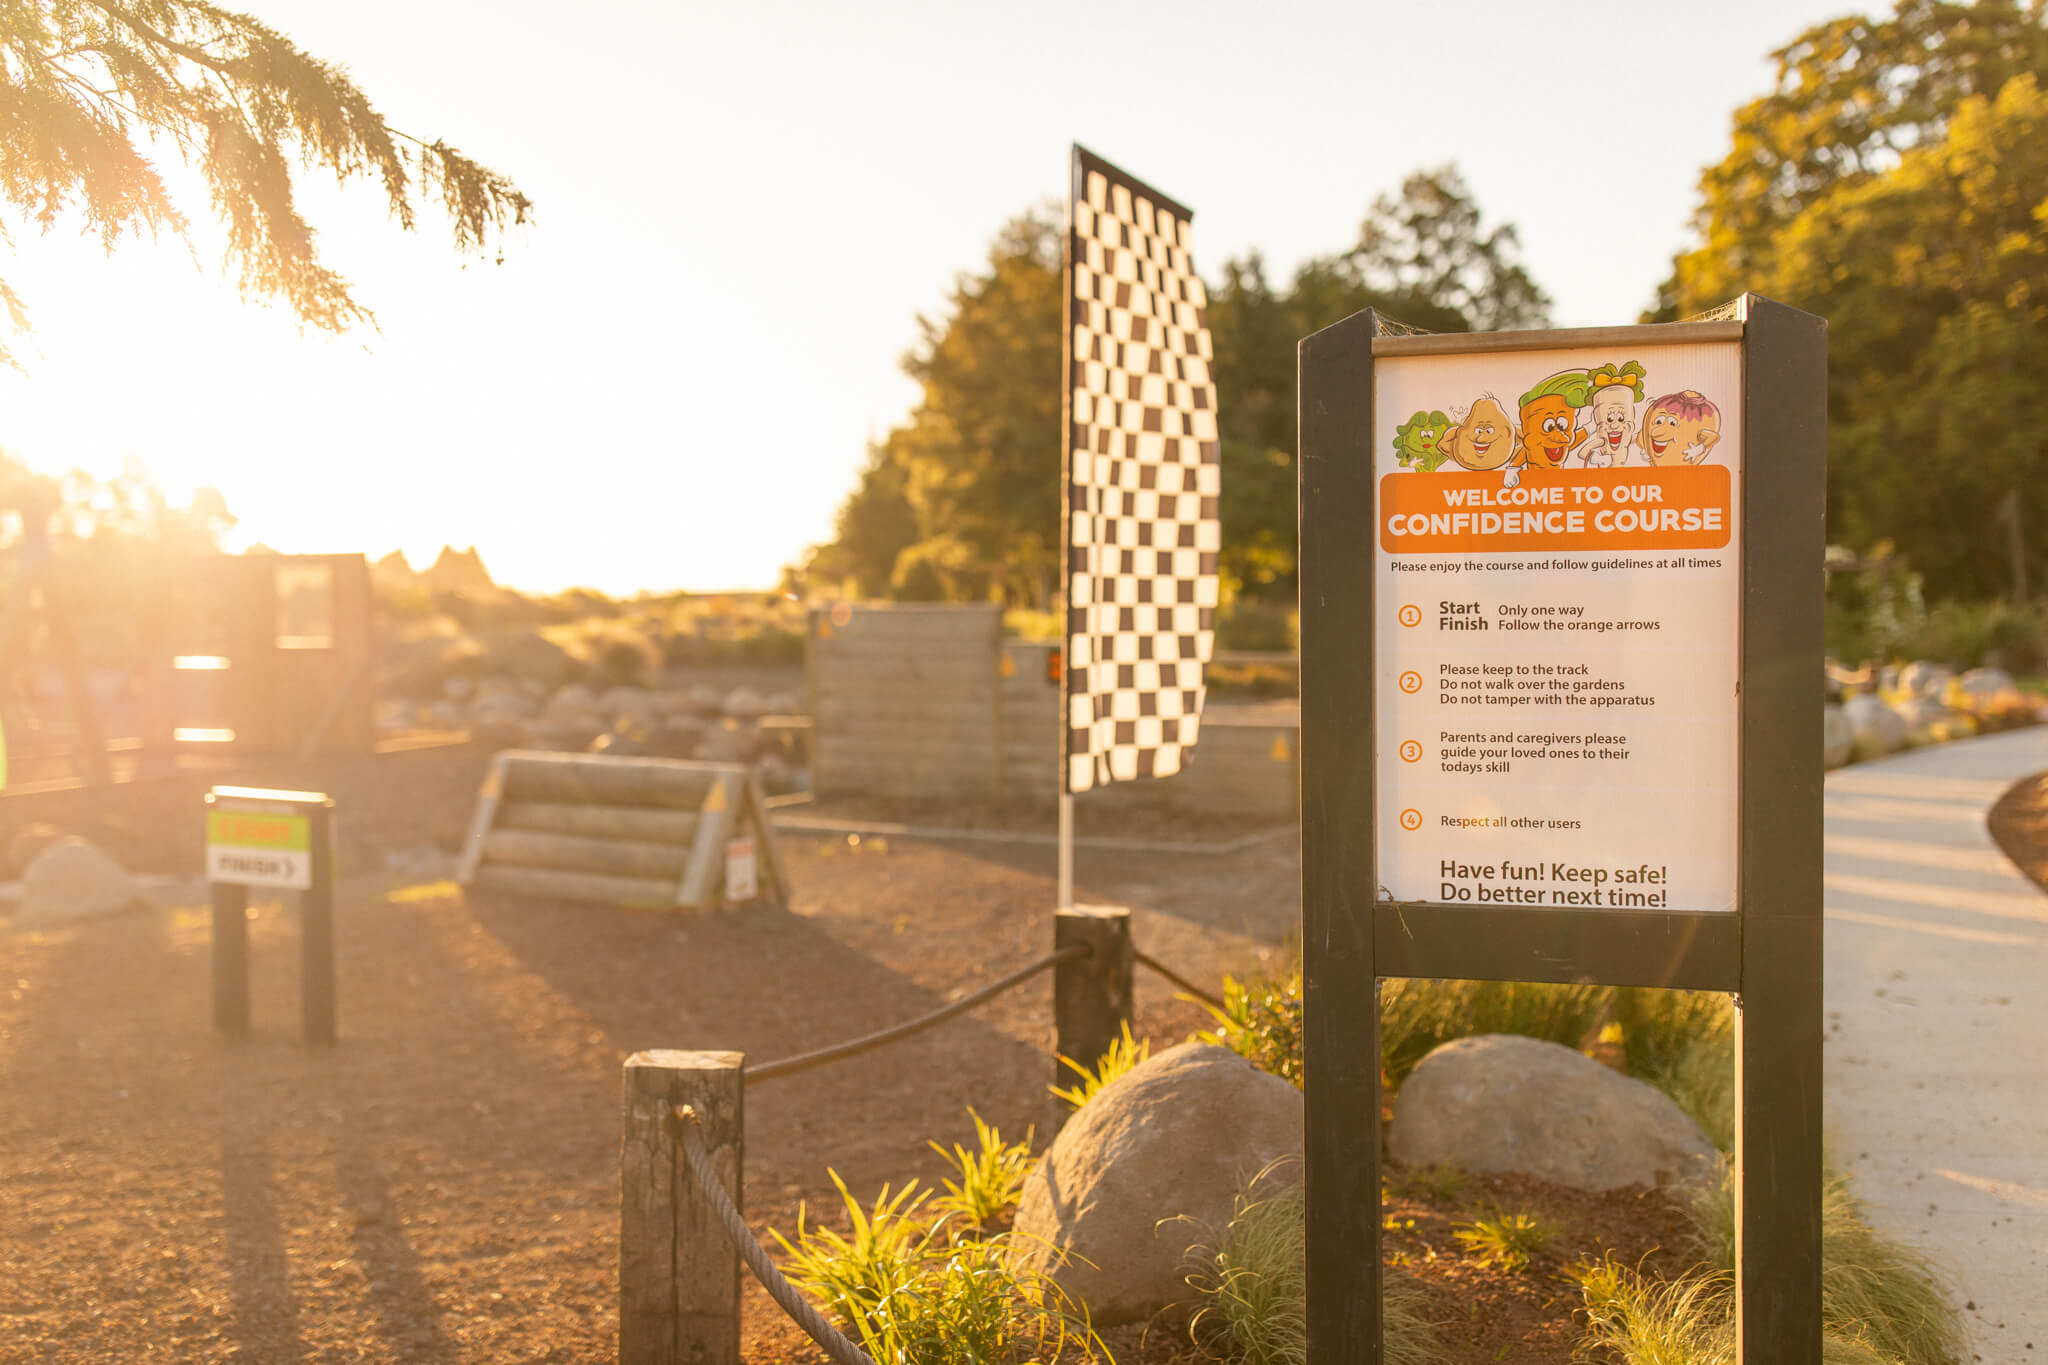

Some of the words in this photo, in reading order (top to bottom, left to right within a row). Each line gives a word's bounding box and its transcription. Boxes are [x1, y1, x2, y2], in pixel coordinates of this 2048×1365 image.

[1443, 487, 1563, 506] WELCOME
[1571, 486, 1603, 503] TO
[1612, 485, 1662, 503] OUR
[1388, 511, 1584, 536] CONFIDENCE
[1595, 508, 1721, 532] COURSE
[1391, 561, 1427, 572] Please
[1429, 560, 1462, 574] enjoy
[1463, 560, 1484, 571] the
[1485, 562, 1525, 571] course
[1526, 559, 1549, 570] and
[1551, 559, 1589, 570] follow
[1591, 558, 1654, 572] guidelines
[1656, 559, 1668, 569] at
[1670, 557, 1685, 569] all
[1688, 557, 1722, 568] times
[1439, 600, 1481, 615] Start
[1498, 604, 1528, 618] Only
[1530, 607, 1556, 616] one
[1558, 606, 1585, 618] way
[1439, 616, 1489, 631] Finish
[1498, 618, 1541, 631] Follow
[1542, 619, 1565, 631] the
[1567, 621, 1614, 633] orange
[1616, 621, 1661, 630] arrows
[1440, 663, 1480, 675] Please
[1482, 663, 1514, 678] keep
[1516, 664, 1530, 675] to
[1532, 663, 1554, 675] the
[1556, 663, 1589, 675] track
[1440, 678, 1458, 690] Do
[1460, 679, 1483, 690] not
[1484, 678, 1515, 690] walk
[1517, 681, 1546, 690] over
[1548, 678, 1570, 690] the
[1572, 678, 1625, 693] gardens
[1440, 693, 1458, 705] Do
[1461, 694, 1483, 705] not
[1485, 694, 1532, 708] tamper
[1534, 693, 1562, 705] with
[1565, 693, 1587, 705] the
[1589, 695, 1655, 708] apparatus
[1440, 731, 1487, 743] Parents
[1489, 731, 1514, 743] and
[1517, 733, 1581, 746] caregivers
[1585, 733, 1626, 746] please
[1441, 747, 1476, 760] guide
[1480, 749, 1508, 761] your
[1511, 746, 1546, 759] loved
[1548, 750, 1580, 759] ones
[1582, 748, 1597, 759] to
[1599, 747, 1630, 760] their
[1441, 760, 1483, 775] todays
[1485, 761, 1510, 773] skill
[1440, 815, 1490, 830] Respect
[1492, 815, 1508, 828] all
[1510, 816, 1545, 829] other
[1547, 820, 1582, 830] users
[1441, 860, 1495, 879] Have
[1501, 861, 1544, 880] fun!
[1552, 864, 1607, 887] Keep
[1615, 865, 1666, 884] safe!
[1441, 883, 1471, 901] Do
[1478, 883, 1546, 904] better
[1553, 889, 1602, 906] next
[1608, 888, 1666, 908] time!
